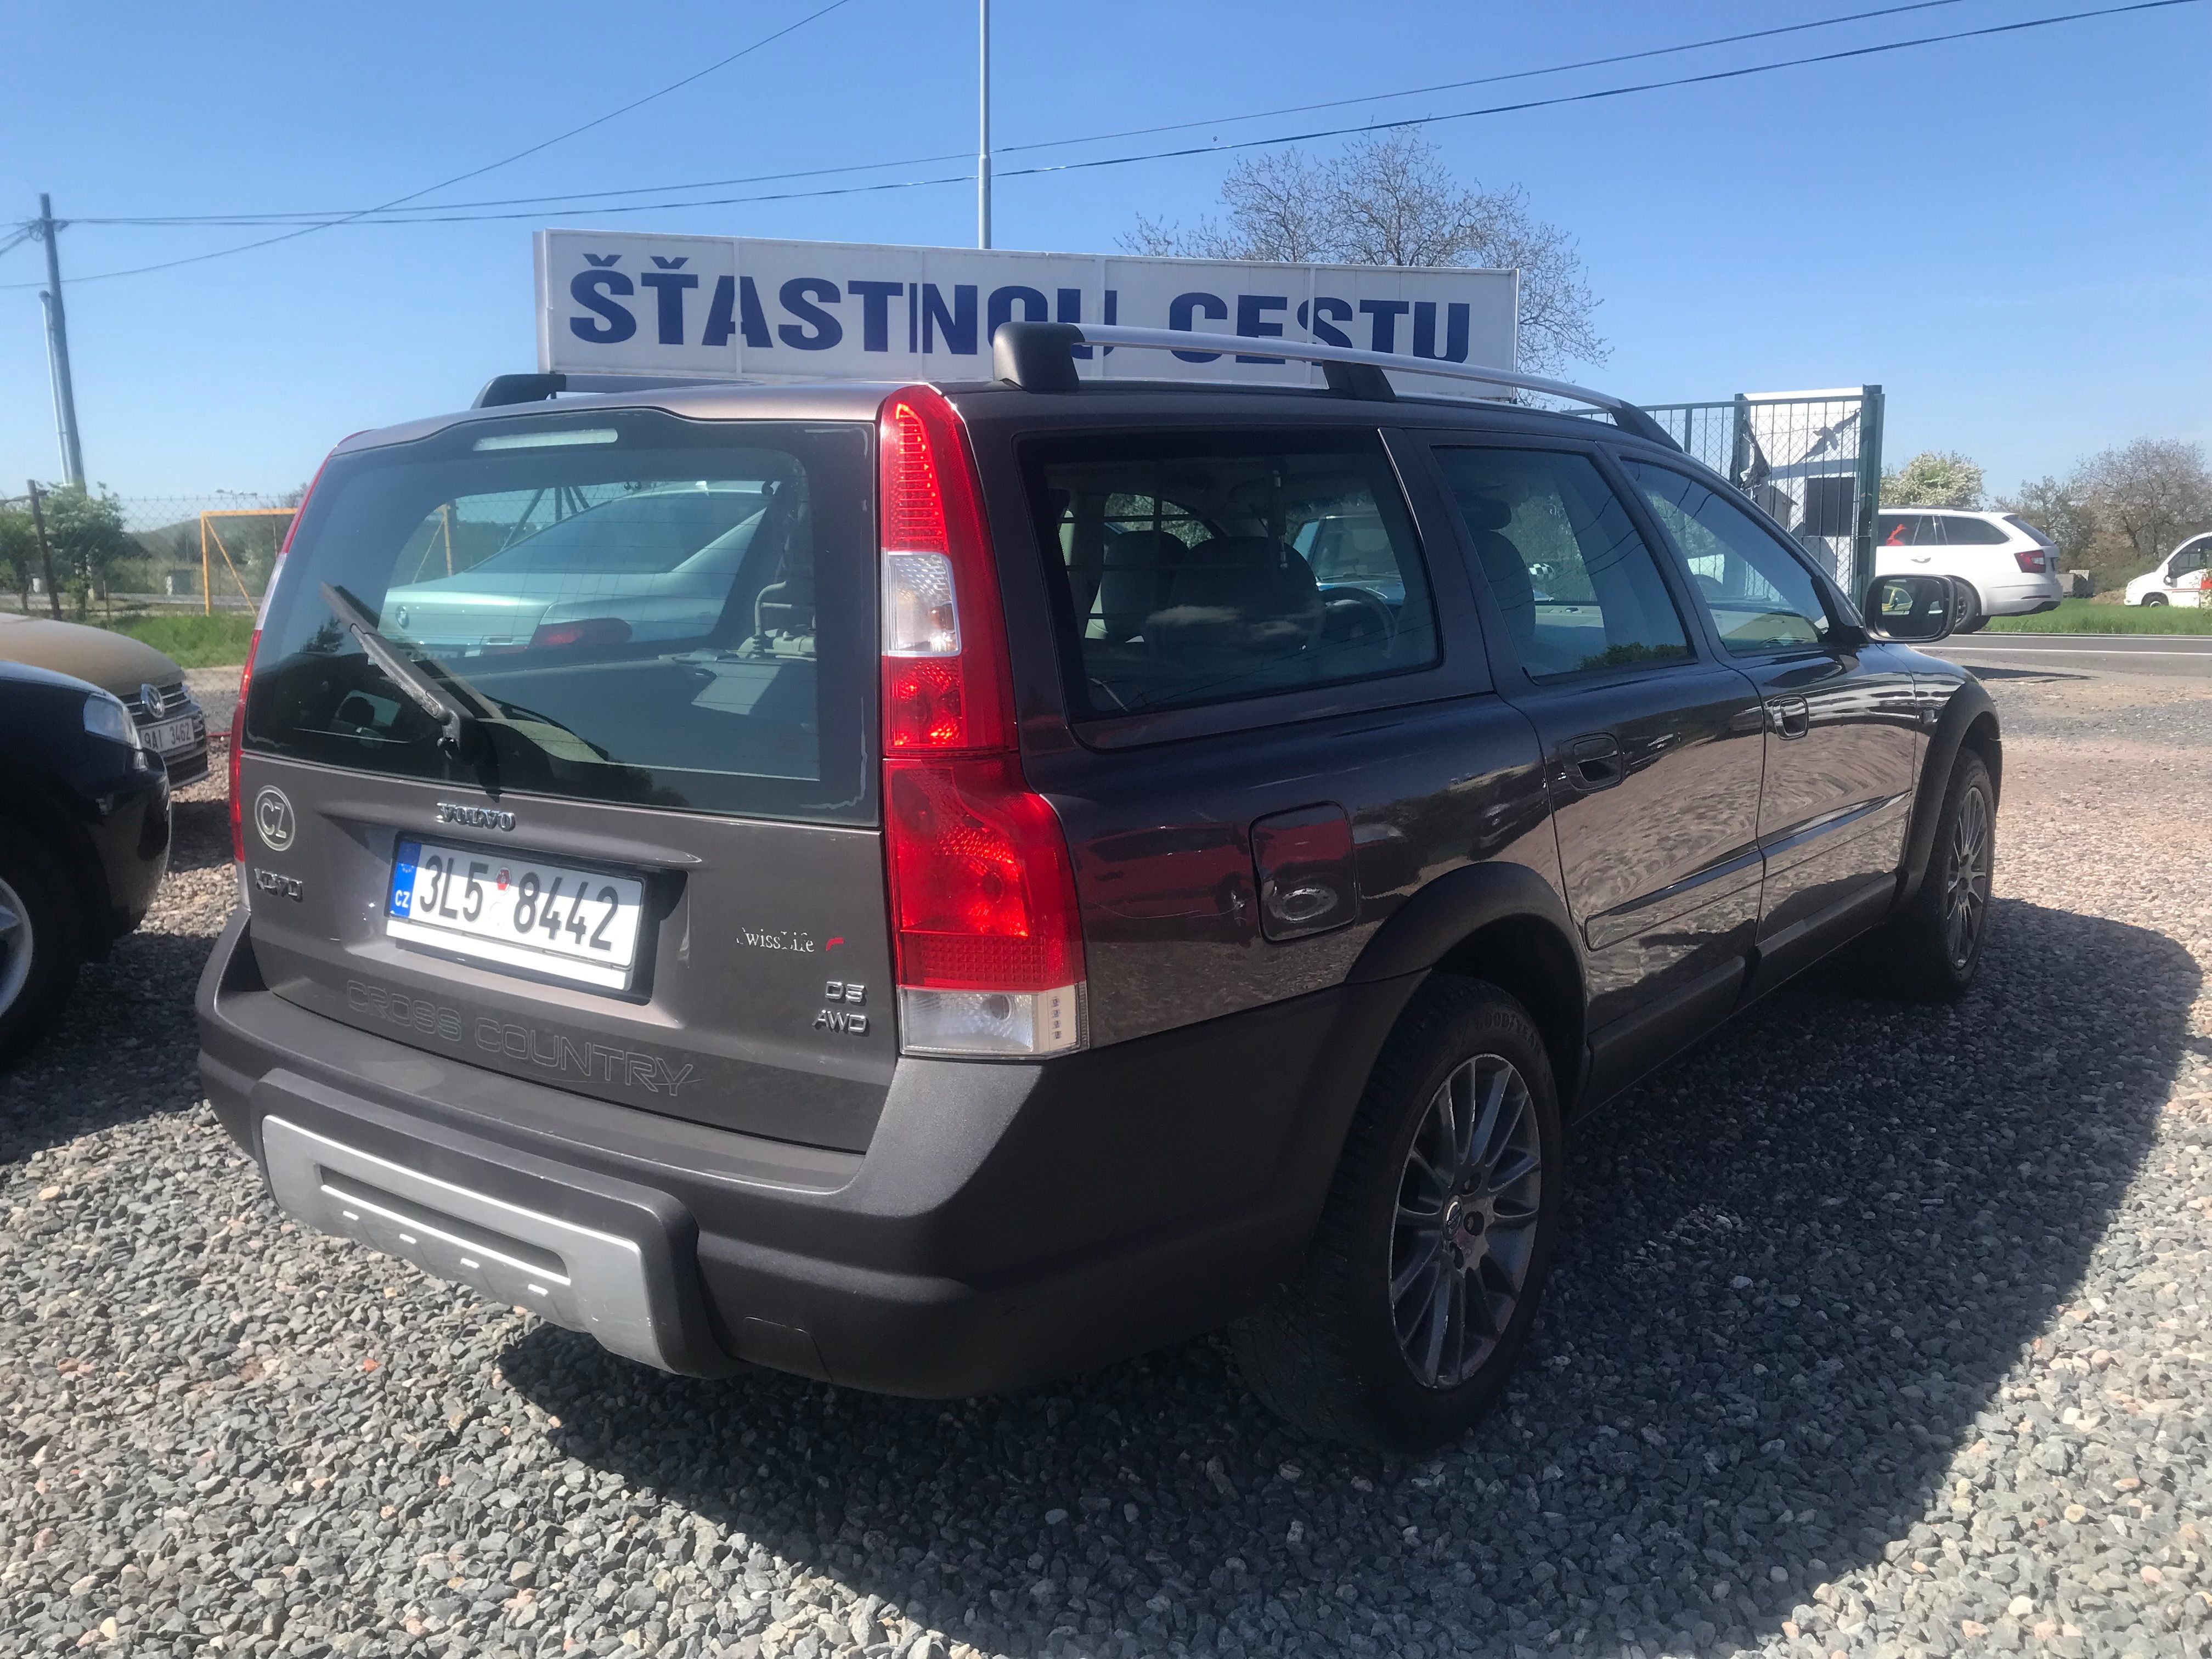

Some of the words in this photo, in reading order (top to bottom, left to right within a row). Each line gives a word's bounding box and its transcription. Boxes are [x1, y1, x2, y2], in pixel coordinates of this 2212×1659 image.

[1169, 292, 1470, 366] CESTU
[261, 799, 287, 839] CZ
[437, 803, 516, 832] VOLVO
[394, 889, 410, 909] CZ
[420, 855, 488, 922] 3L5
[514, 872, 619, 951] 8442
[347, 979, 462, 1042] CROSS
[475, 1017, 693, 1097] COUNTRY
[812, 1009, 866, 1032] AWD
